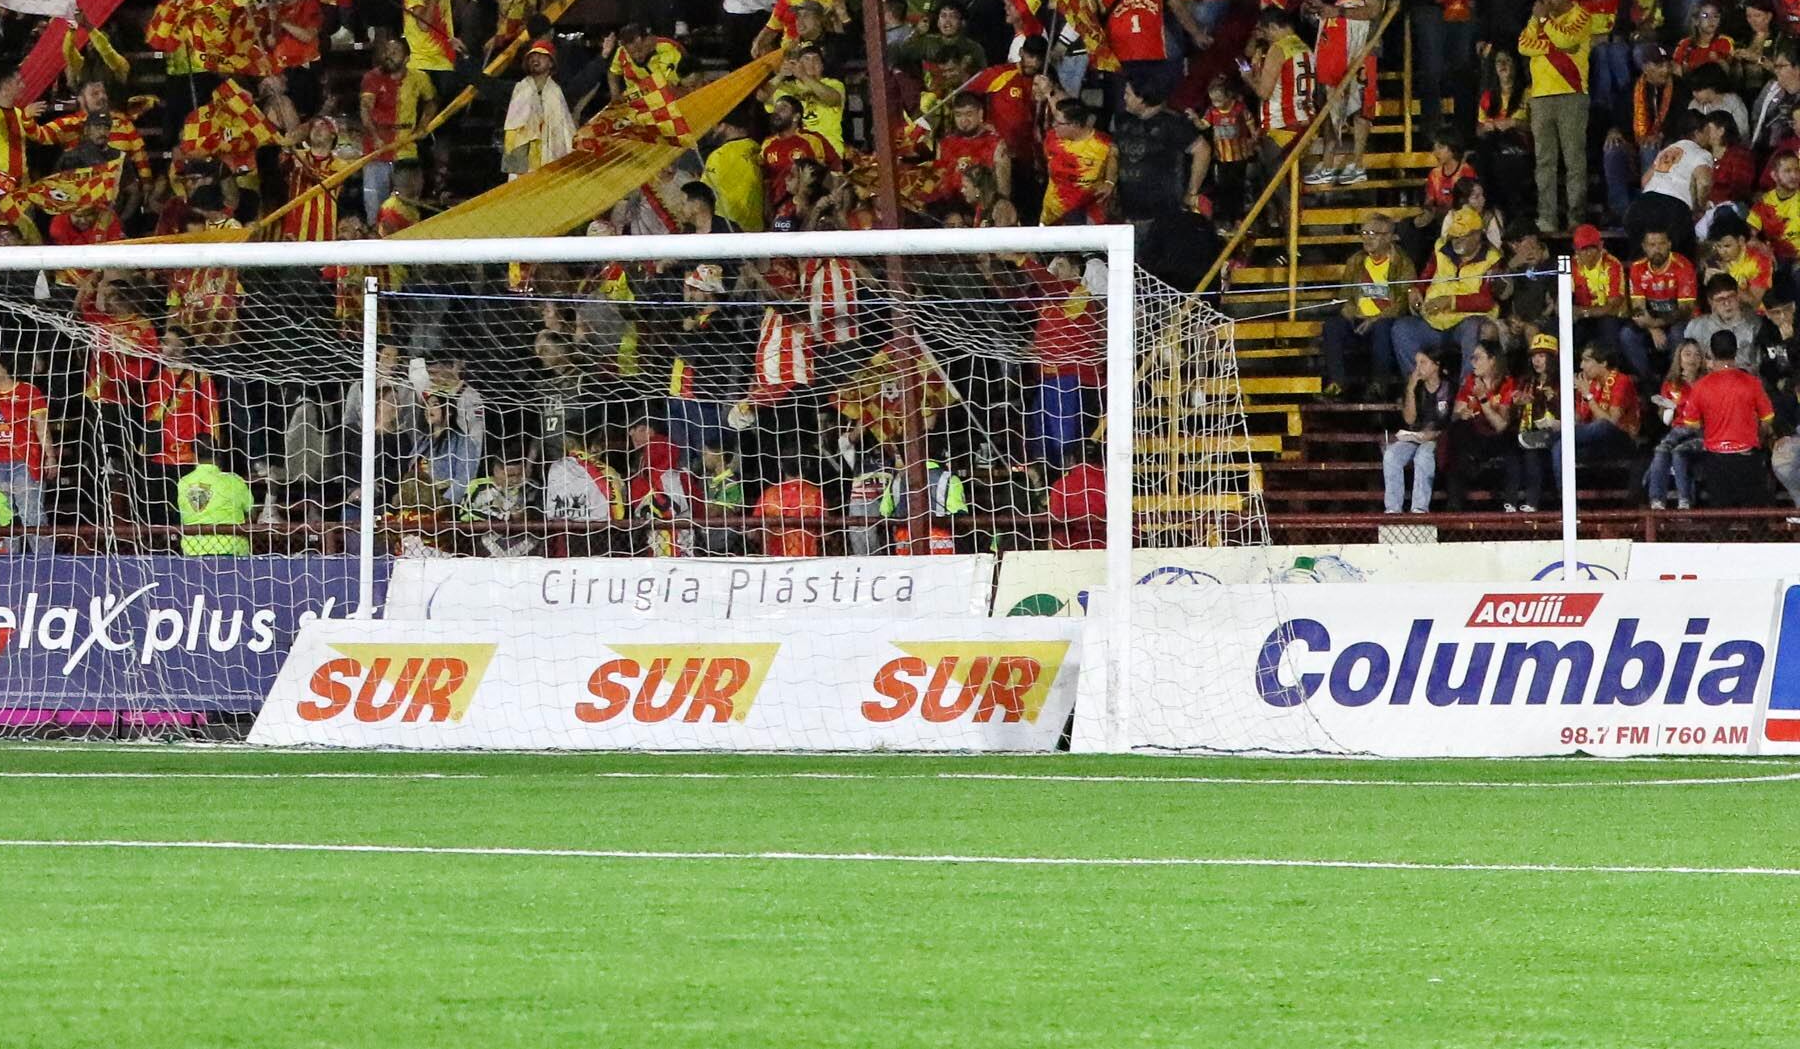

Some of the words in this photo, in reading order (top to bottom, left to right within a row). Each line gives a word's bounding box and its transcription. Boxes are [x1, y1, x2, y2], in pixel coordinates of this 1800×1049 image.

[542, 567, 700, 611] Cirugía
[726, 566, 915, 619] Plástica
[141, 595, 277, 665] plus
[1255, 618, 1766, 707] Columbia
[297, 657, 469, 723] SUR
[574, 658, 751, 723] SUR
[860, 656, 1042, 723] SUR
[1560, 726, 1609, 745] 98.7
[1616, 726, 1650, 745] FM
[1665, 726, 1706, 745] 760
[1713, 725, 1748, 745] AM
